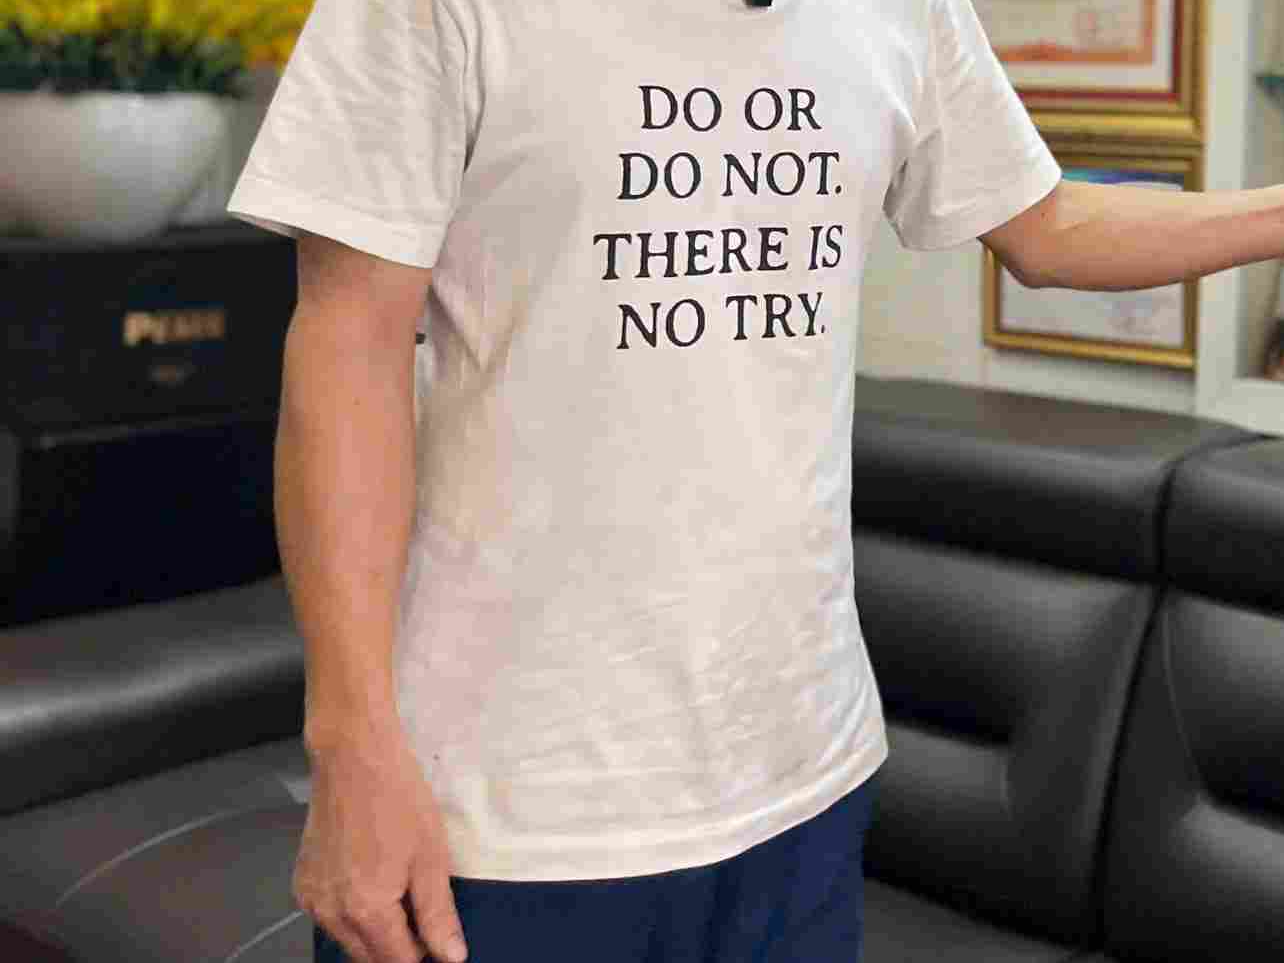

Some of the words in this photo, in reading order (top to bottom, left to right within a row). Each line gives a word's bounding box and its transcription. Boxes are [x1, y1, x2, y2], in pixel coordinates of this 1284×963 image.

[638, 85, 722, 132] DO
[744, 87, 822, 131] OR
[617, 152, 701, 200] DO
[721, 151, 842, 197] NOT.
[593, 227, 789, 280] THERE
[807, 224, 843, 270] IS
[616, 298, 706, 350] NO
[725, 292, 826, 340] TRY.
